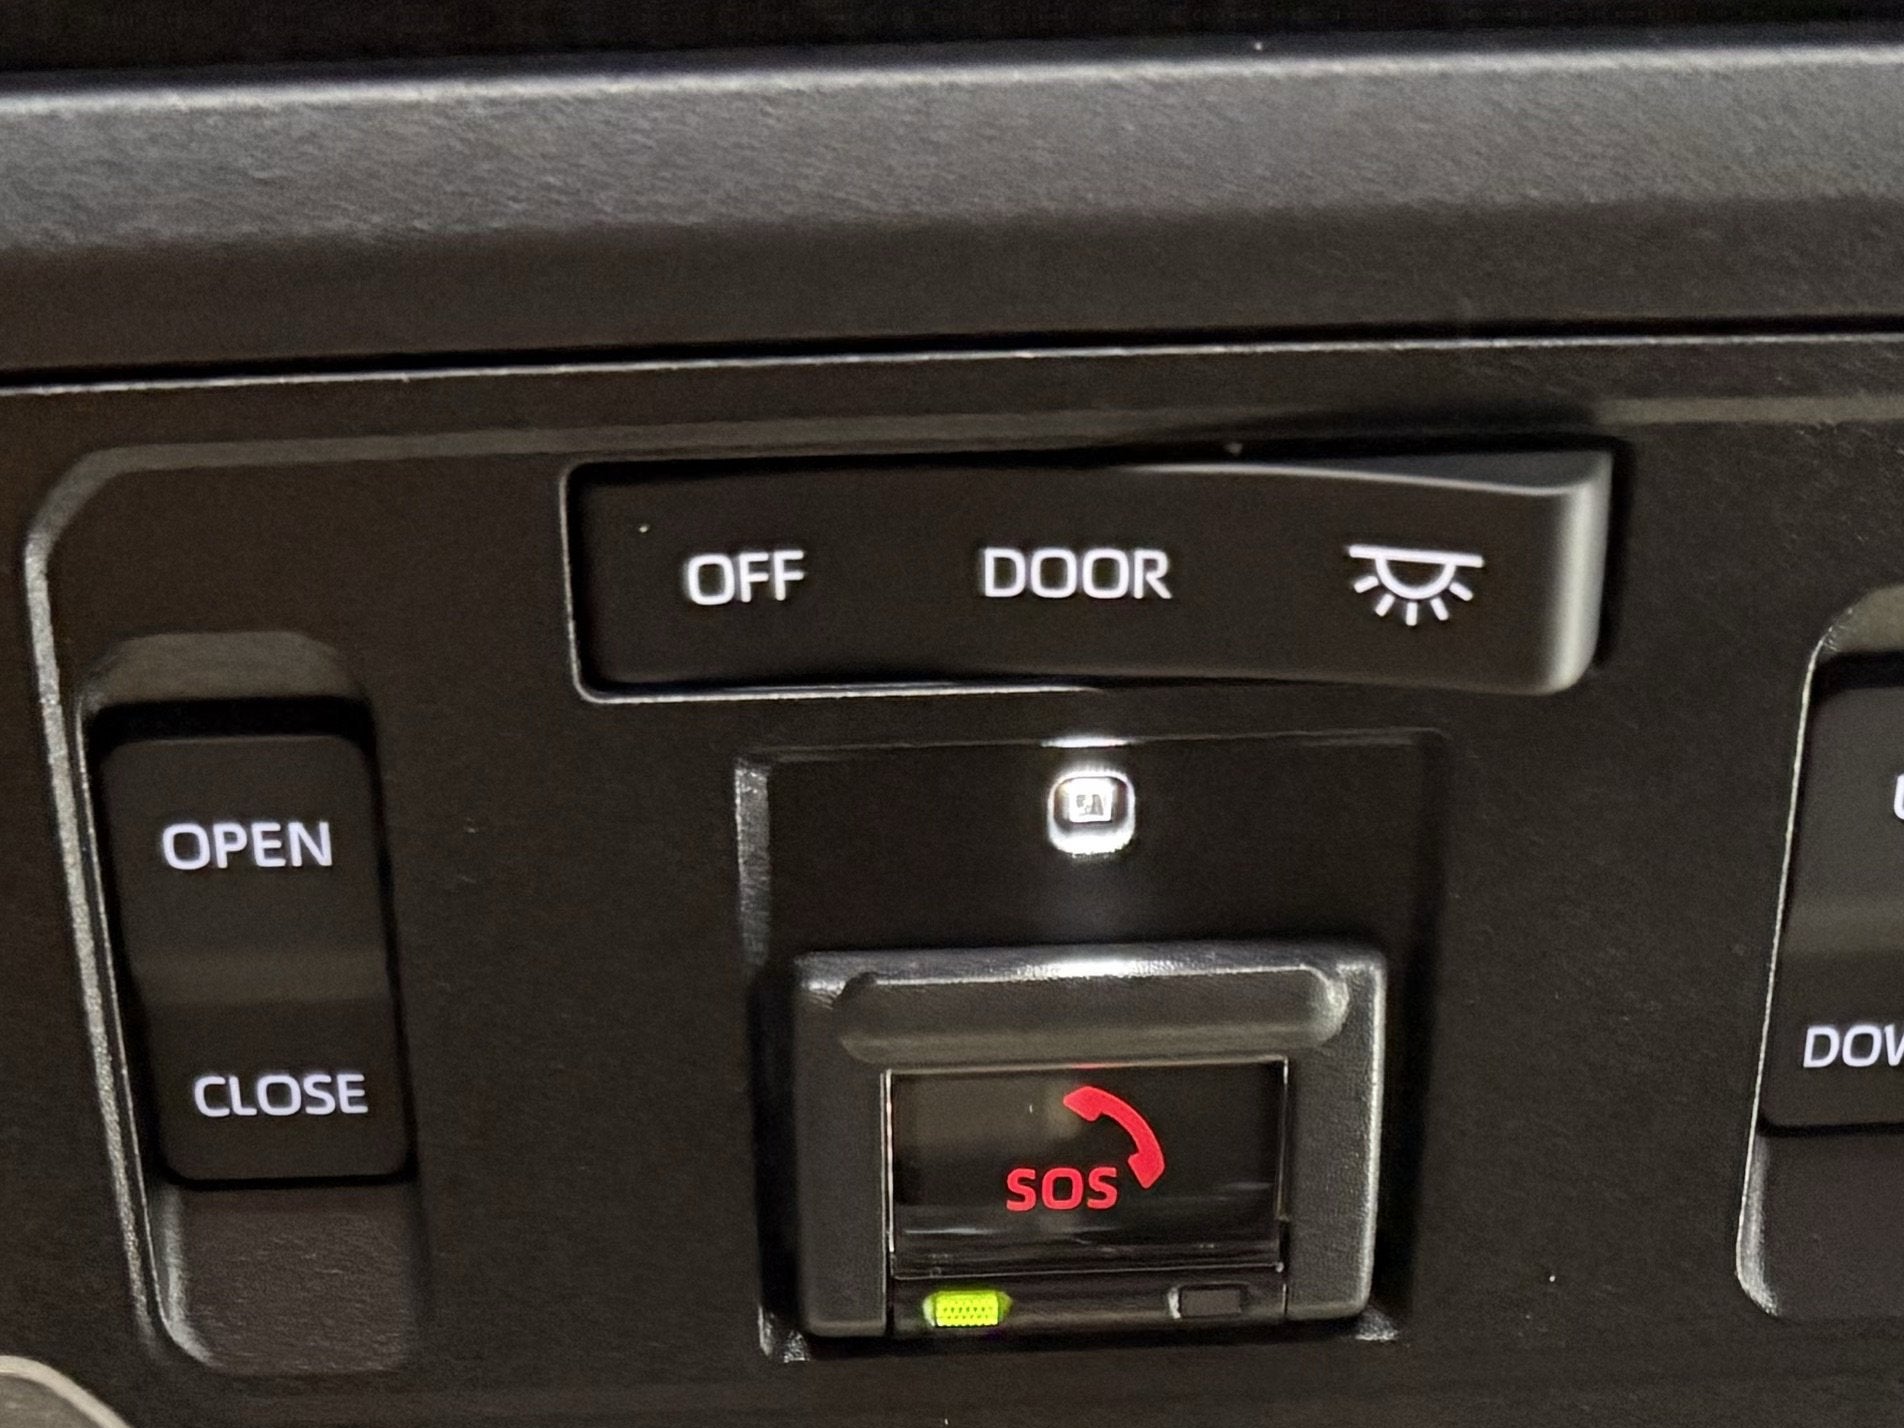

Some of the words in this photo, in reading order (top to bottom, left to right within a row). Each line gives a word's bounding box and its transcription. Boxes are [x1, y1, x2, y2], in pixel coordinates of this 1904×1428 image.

[683, 548, 807, 607] OFF
[981, 546, 1172, 601] DOOR
[161, 820, 334, 871] OPEN
[192, 1072, 369, 1118] CLOSE
[1005, 1165, 1119, 1212] SOS
